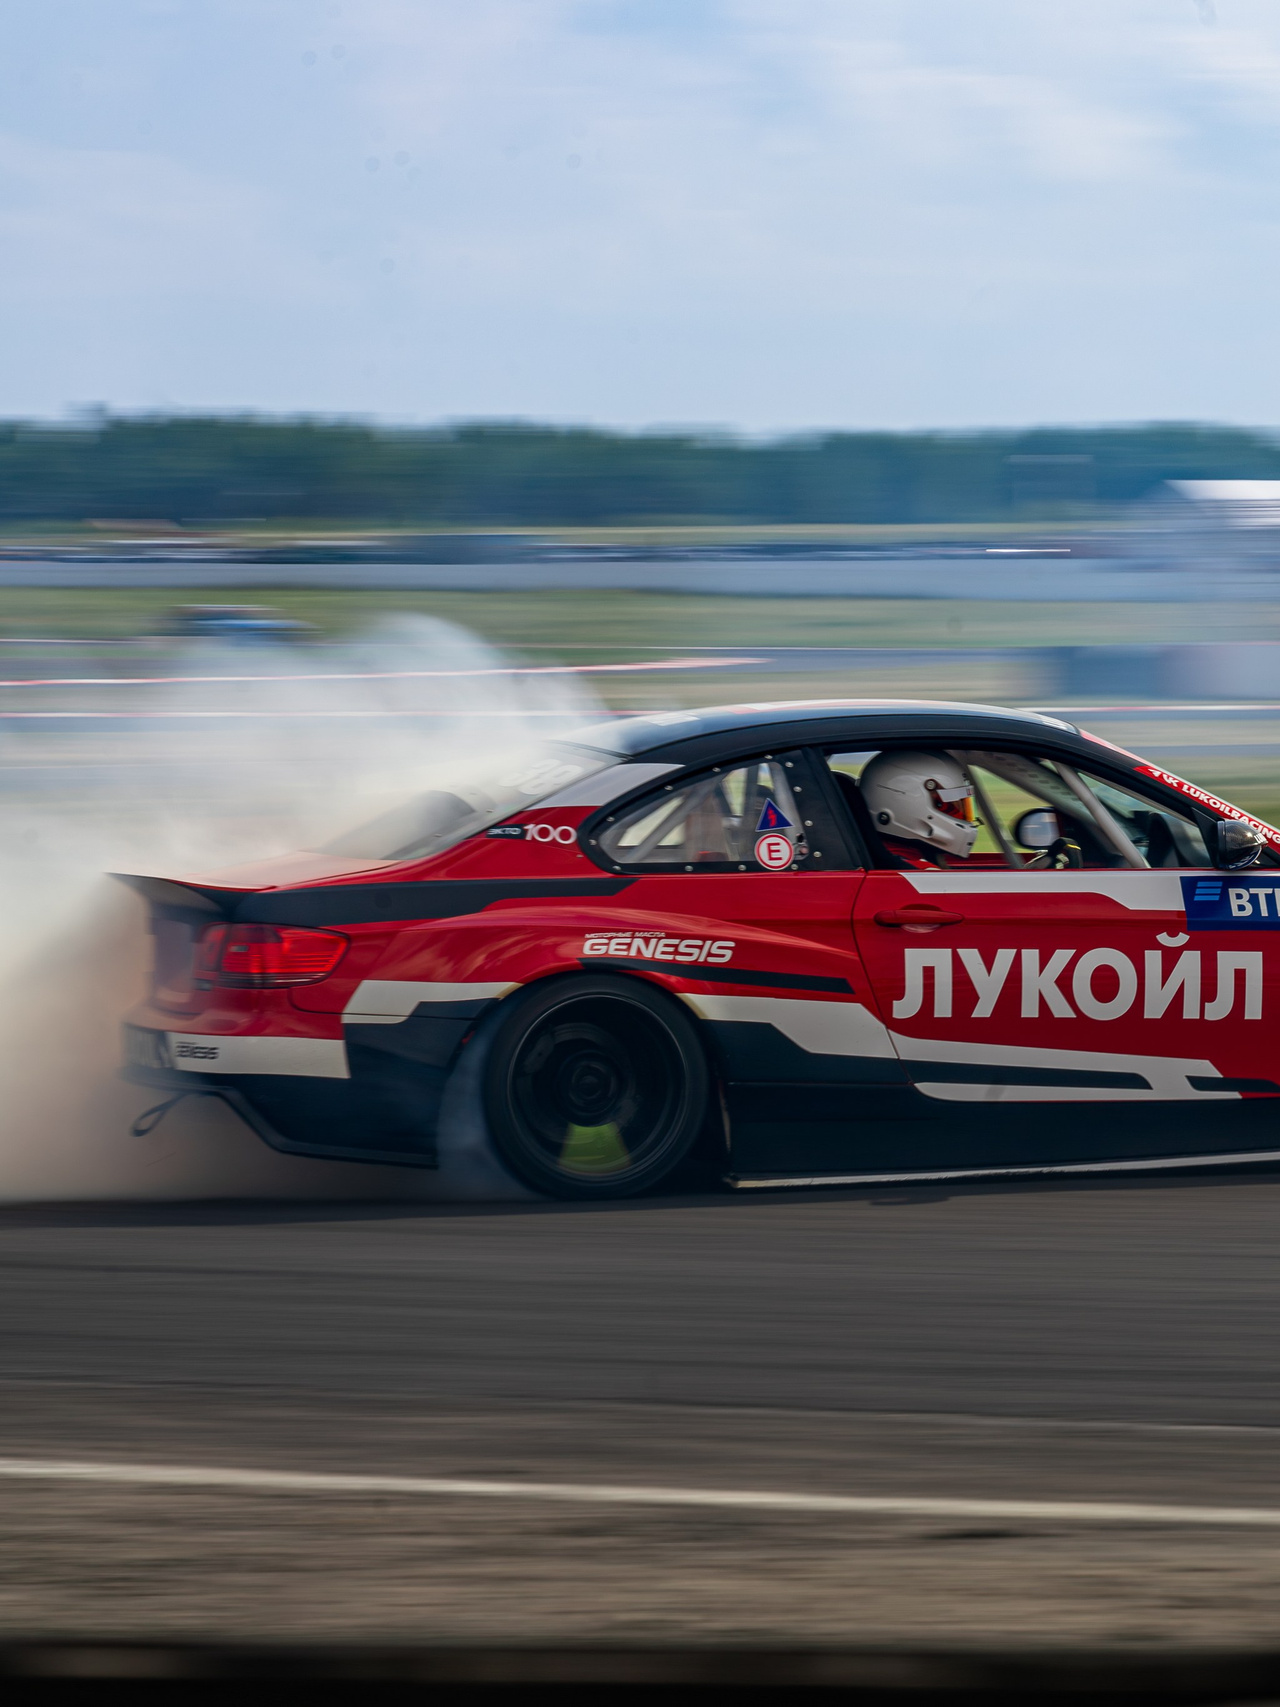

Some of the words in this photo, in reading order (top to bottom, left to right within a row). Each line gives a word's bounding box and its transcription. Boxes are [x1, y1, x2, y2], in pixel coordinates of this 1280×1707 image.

[523, 823, 577, 844] 100
[583, 938, 736, 963] GENESIS
[892, 931, 1263, 1021] ЛУКОЙЛ
